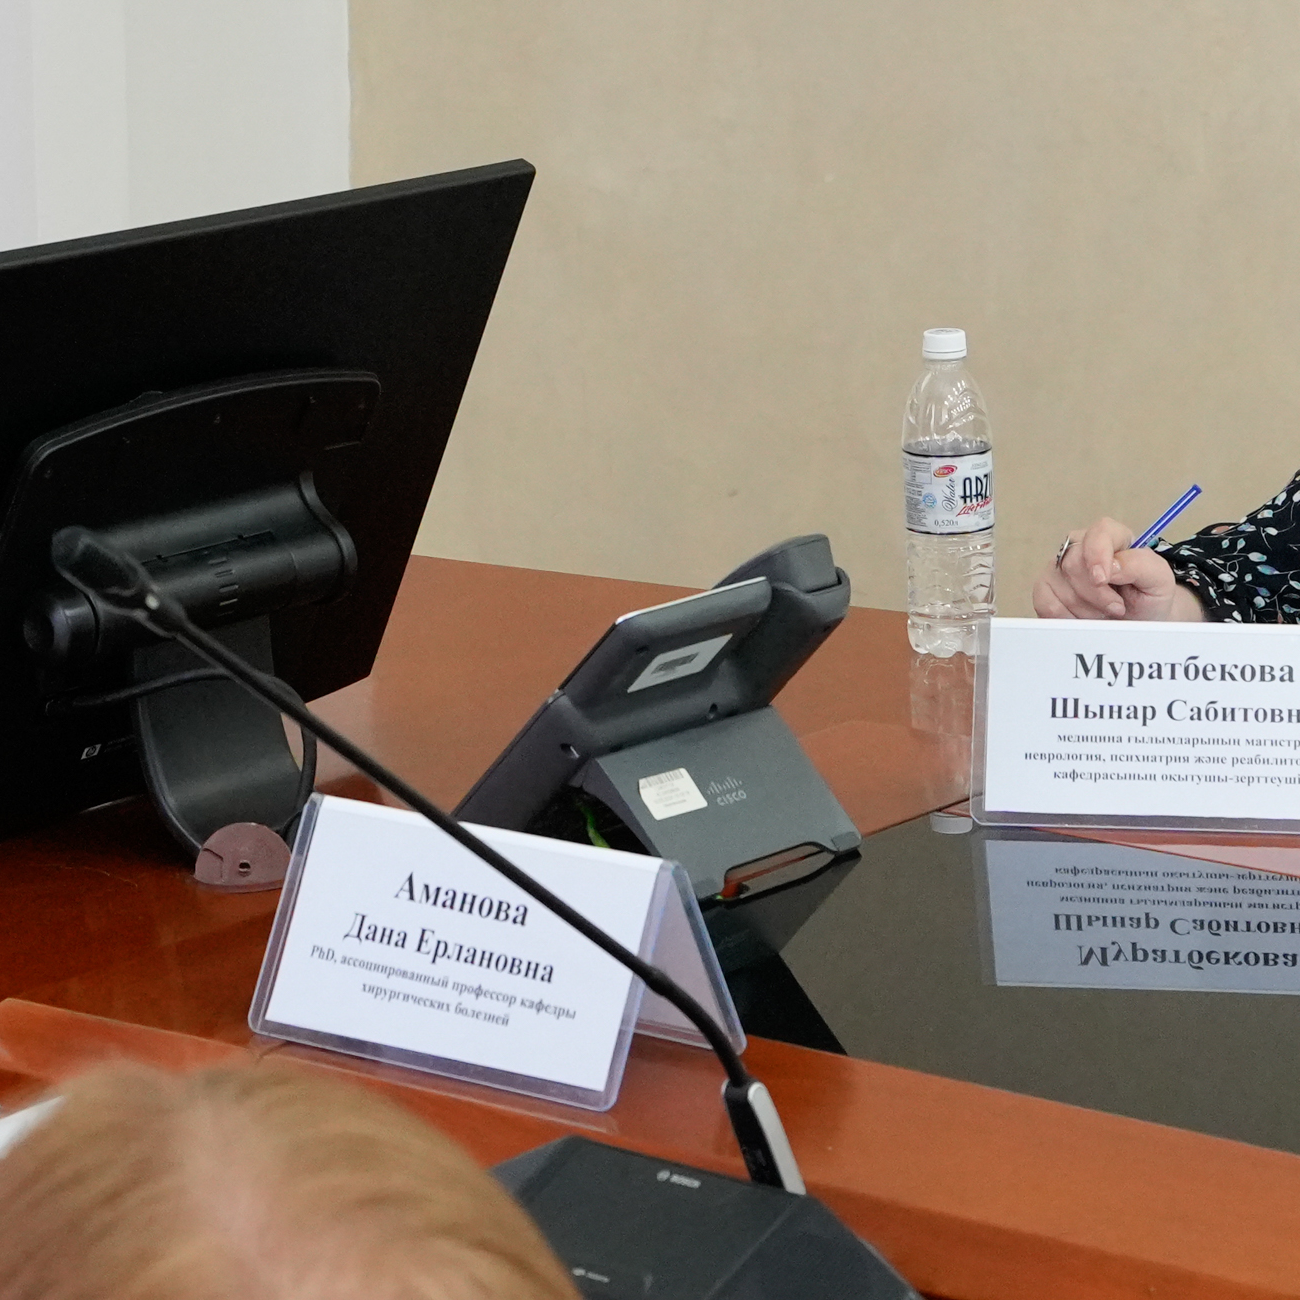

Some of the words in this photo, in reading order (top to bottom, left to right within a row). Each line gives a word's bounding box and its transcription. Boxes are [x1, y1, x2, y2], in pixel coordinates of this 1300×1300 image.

[1074, 653, 1294, 688] Муратбекова
[1050, 697, 1157, 727] Шынар
[1024, 751, 1106, 764] неврология,
[1110, 753, 1190, 766] психиатрия
[1194, 755, 1227, 766] және
[1057, 734, 1123, 744] медицина
[395, 872, 528, 927] Аманова
[343, 911, 408, 949] Дана
[416, 928, 554, 983] Ерлановна
[310, 945, 337, 963] PhD,
[340, 955, 449, 989] ассоциированный
[451, 981, 517, 1008] профессор
[520, 998, 577, 1020] кафедры
[362, 983, 450, 1013] хирургических
[454, 1002, 510, 1027] болезней
